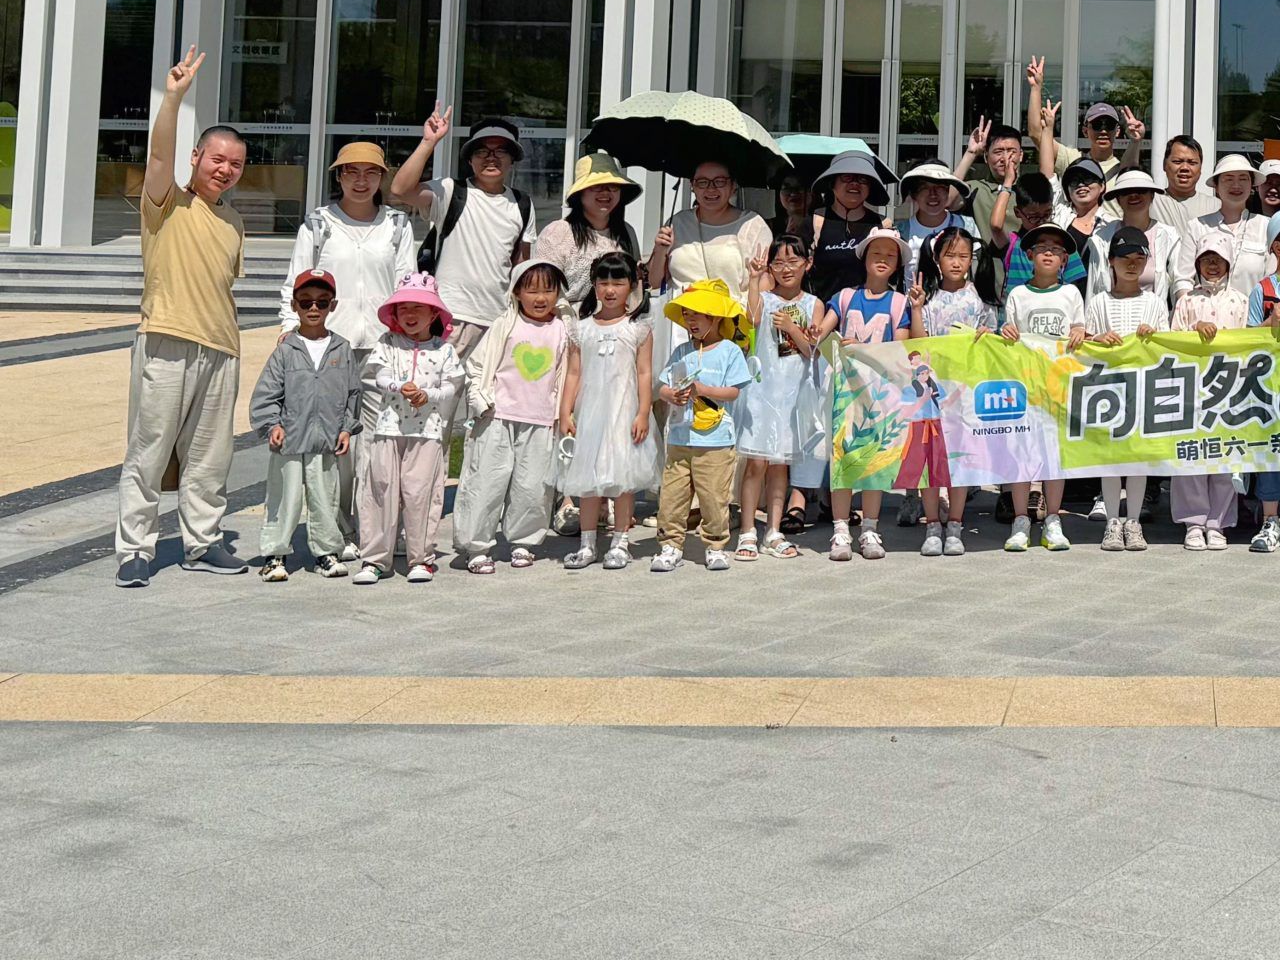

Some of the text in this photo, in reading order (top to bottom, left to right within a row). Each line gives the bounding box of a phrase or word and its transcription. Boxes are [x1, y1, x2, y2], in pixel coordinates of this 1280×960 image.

[825, 238, 858, 251] auth
[844, 310, 891, 343] M
[1032, 316, 1065, 326] RELAY
[1031, 325, 1066, 336] CLASSIC
[972, 425, 1031, 436] NINGBO MH
